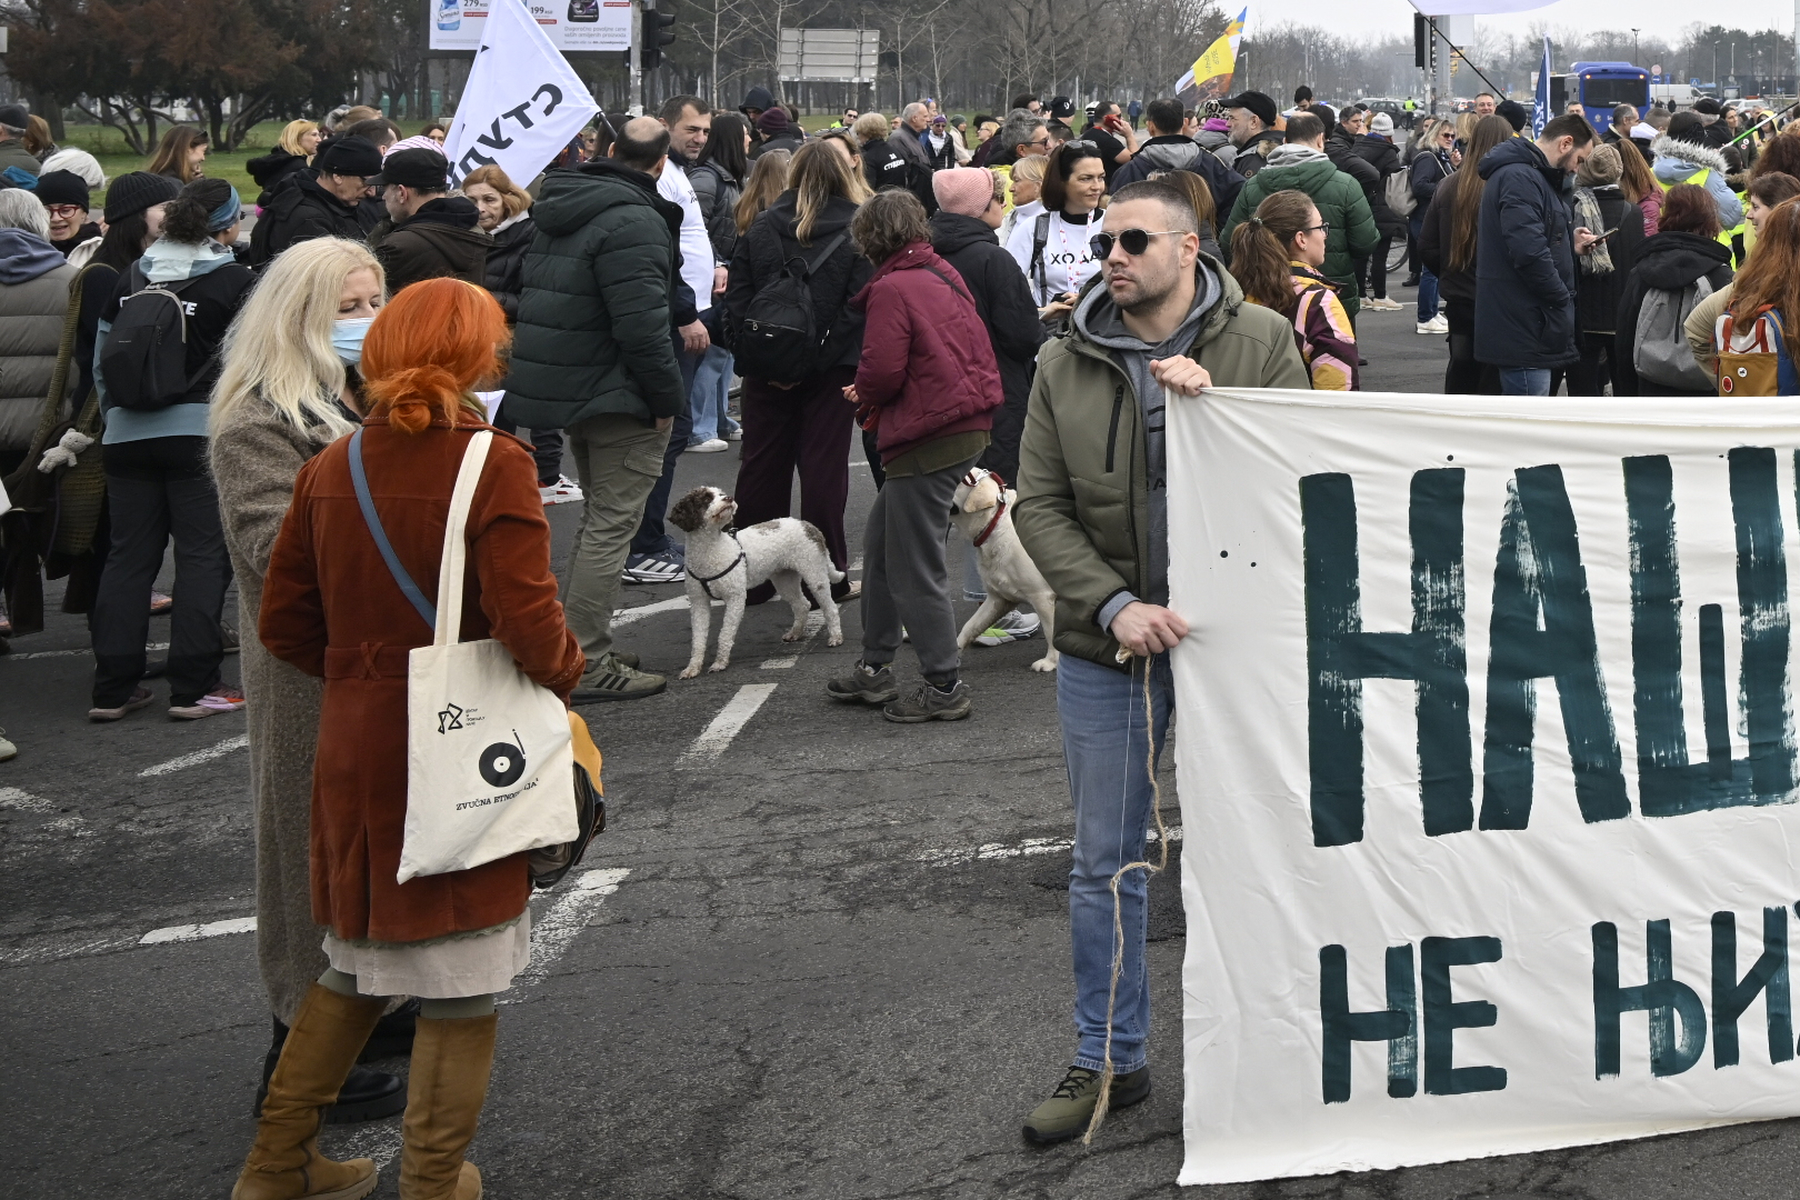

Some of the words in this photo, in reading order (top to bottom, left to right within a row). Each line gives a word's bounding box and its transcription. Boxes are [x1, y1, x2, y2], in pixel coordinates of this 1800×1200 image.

[463, 0, 480, 7] 279
[456, 797, 492, 811] ZVUČNA
[1320, 936, 1508, 1105] НЕ
